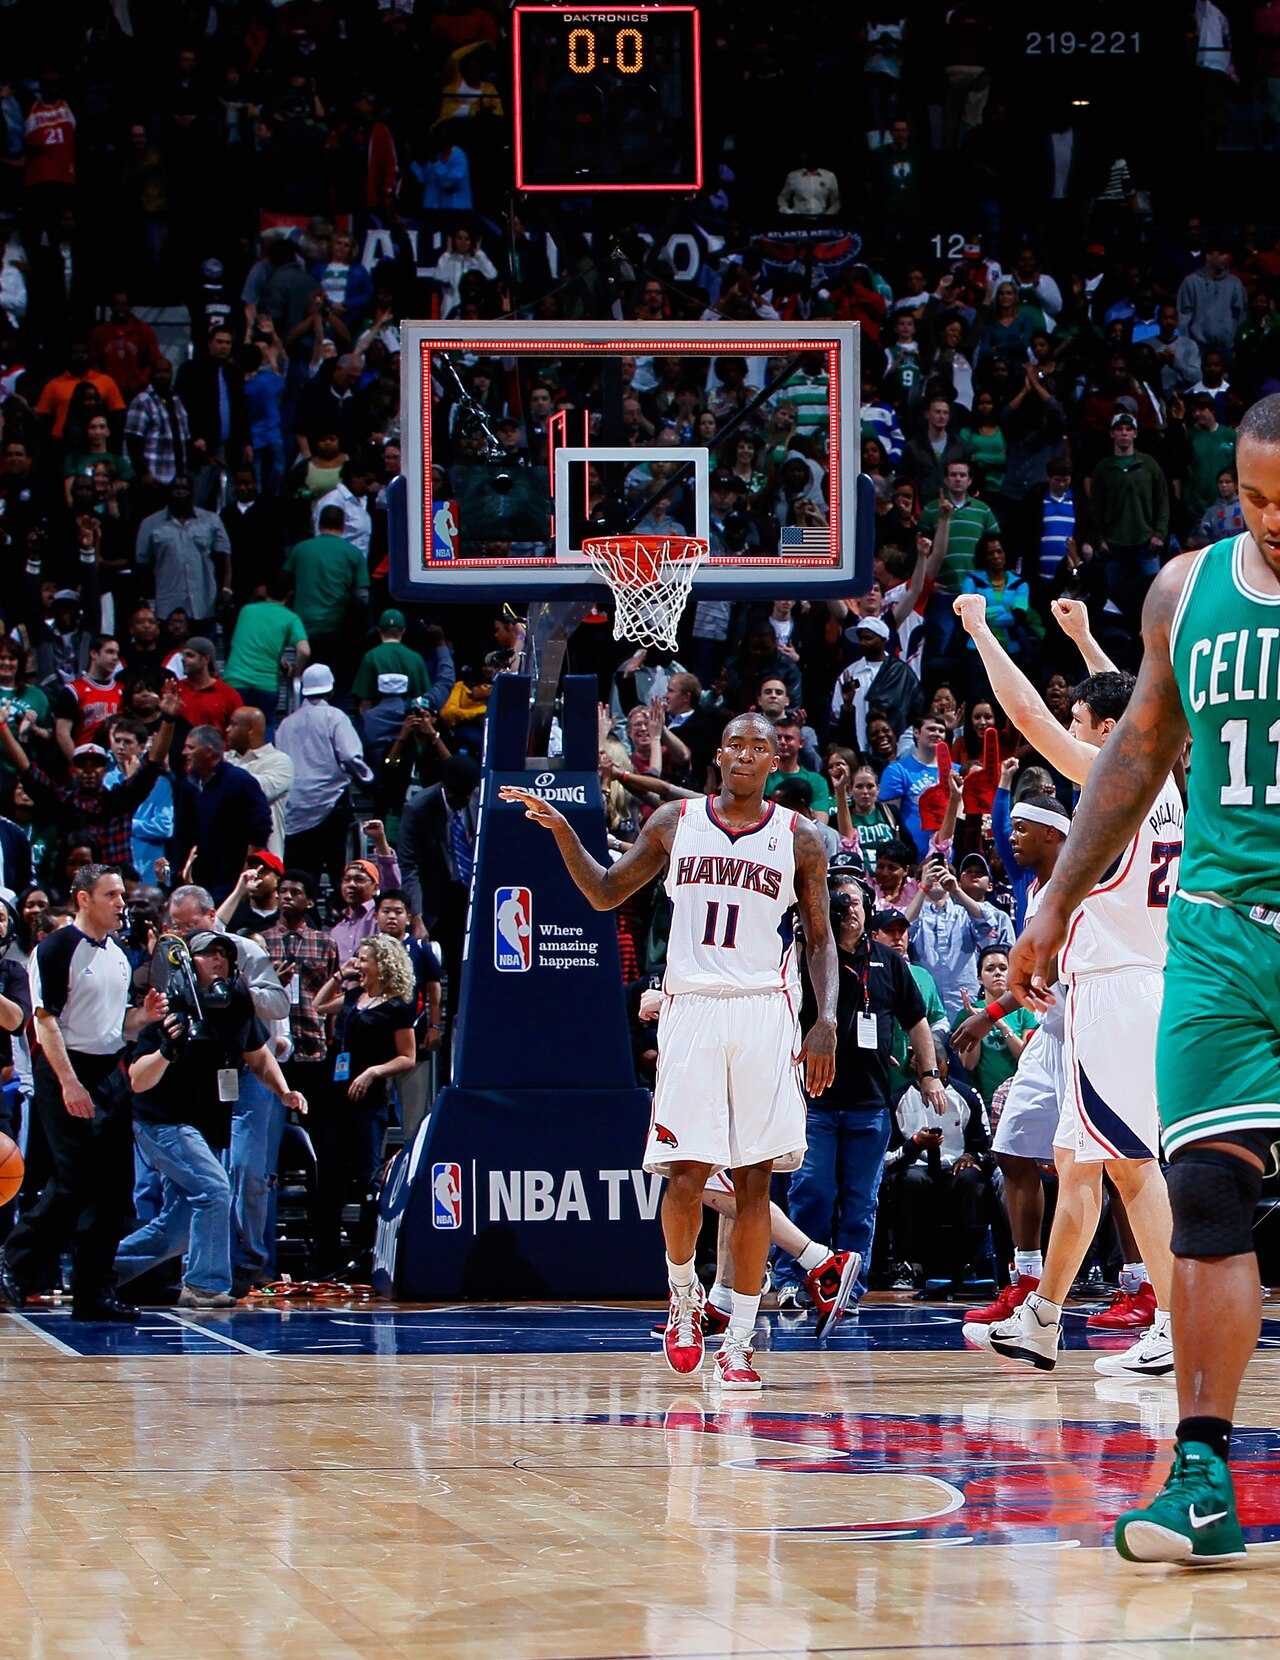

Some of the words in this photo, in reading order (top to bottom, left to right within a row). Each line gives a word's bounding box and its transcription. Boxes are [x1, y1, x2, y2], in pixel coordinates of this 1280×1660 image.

[563, 14, 649, 22] DAKTRONICS
[1025, 31, 1143, 55] 219-221
[569, 29, 642, 73] 0.0
[902, 369, 914, 386] 9
[435, 548, 451, 558] NBA
[676, 856, 782, 901] HAWKS
[539, 925, 583, 936] Where
[701, 901, 739, 949] 11
[539, 941, 598, 954] amazing
[500, 954, 520, 966] NBA
[539, 956, 599, 969] happens.
[489, 1171, 591, 1221] NBA
[599, 1169, 663, 1220] TV
[436, 1215, 453, 1225] NBA
